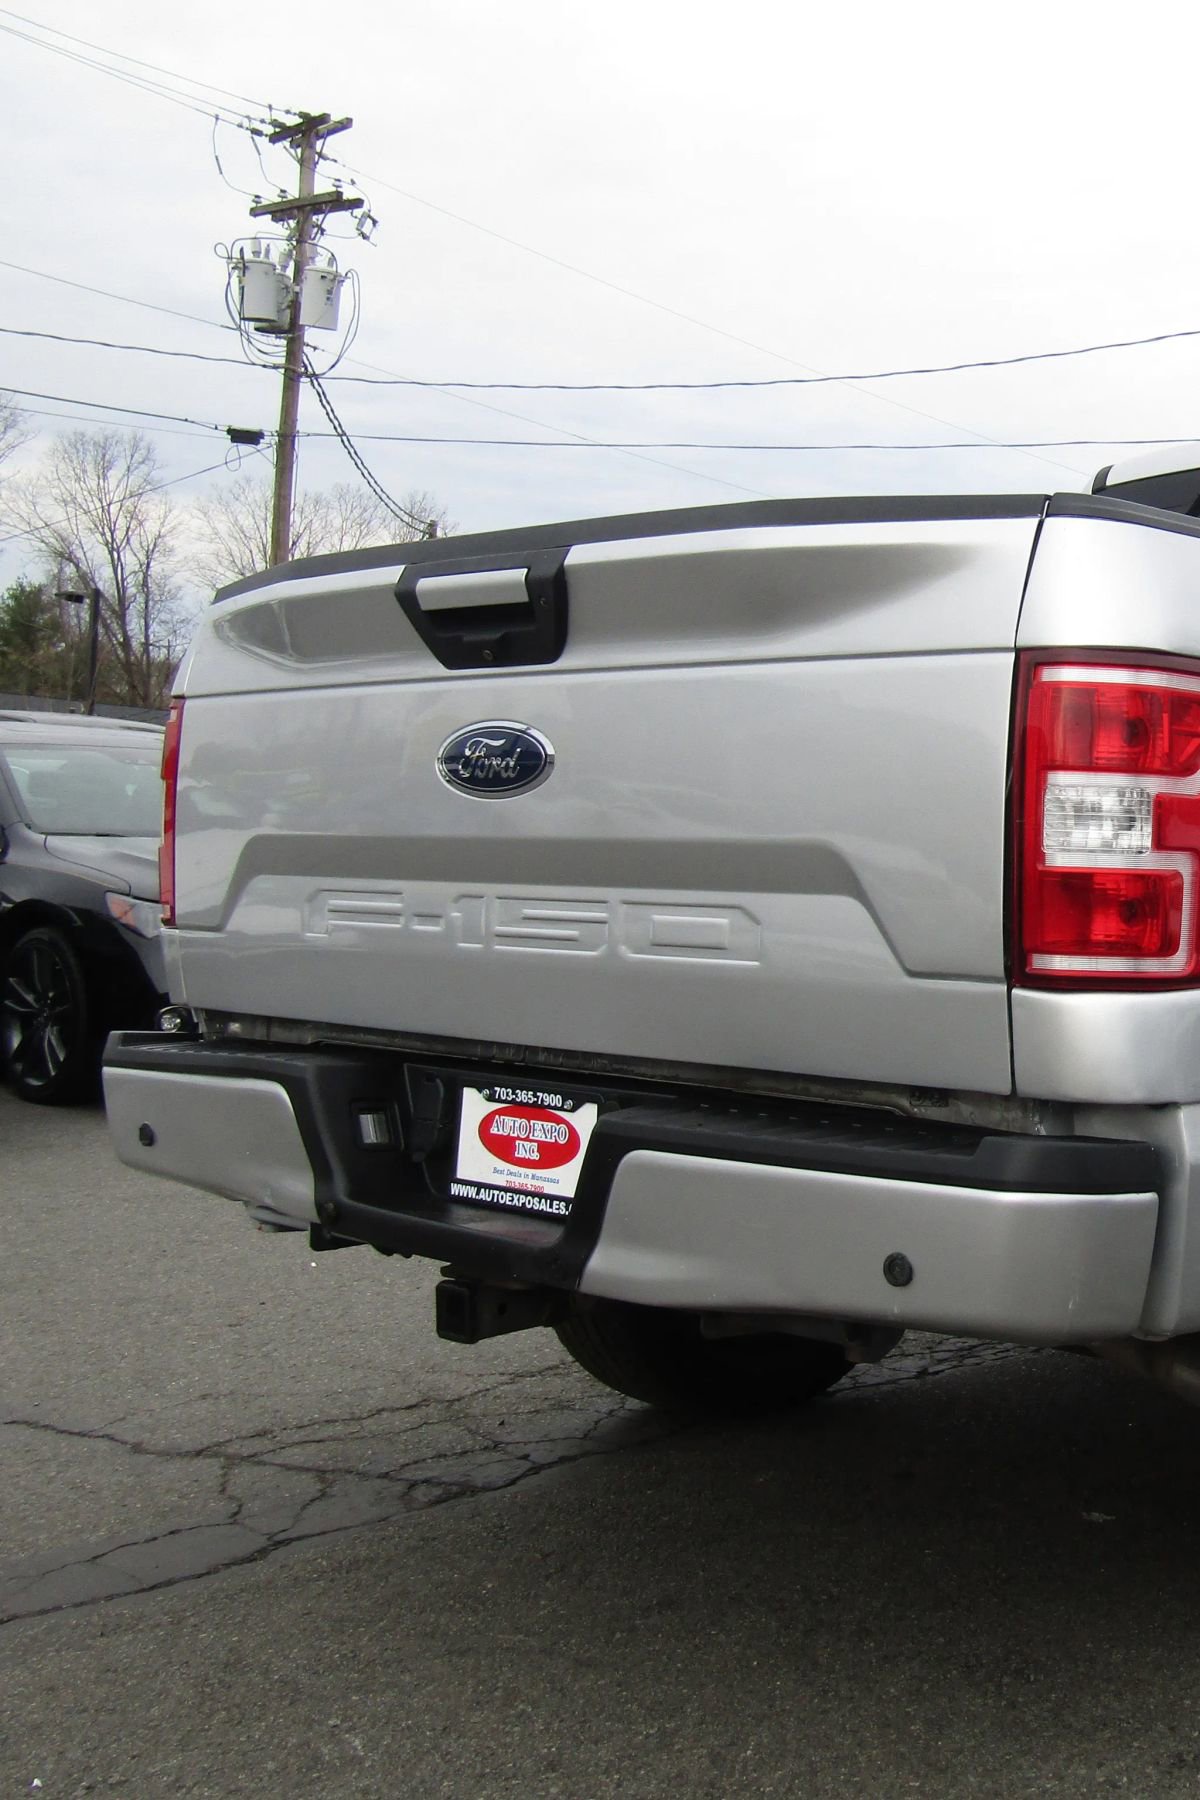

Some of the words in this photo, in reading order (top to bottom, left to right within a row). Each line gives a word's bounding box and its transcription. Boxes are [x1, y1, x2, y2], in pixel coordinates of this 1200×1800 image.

[458, 736, 522, 778] Ford
[304, 888, 763, 967] F-150
[494, 1087, 562, 1107] 703-365-7900
[491, 1116, 530, 1138] AUTO
[531, 1121, 568, 1143] EXPO
[515, 1141, 540, 1160] INC.
[492, 1166, 505, 1176] Best
[506, 1168, 522, 1179] Deals
[505, 1180, 545, 1193] 703-365-7900
[450, 1183, 573, 1215] WWW.AUTOEXPOSALES.
